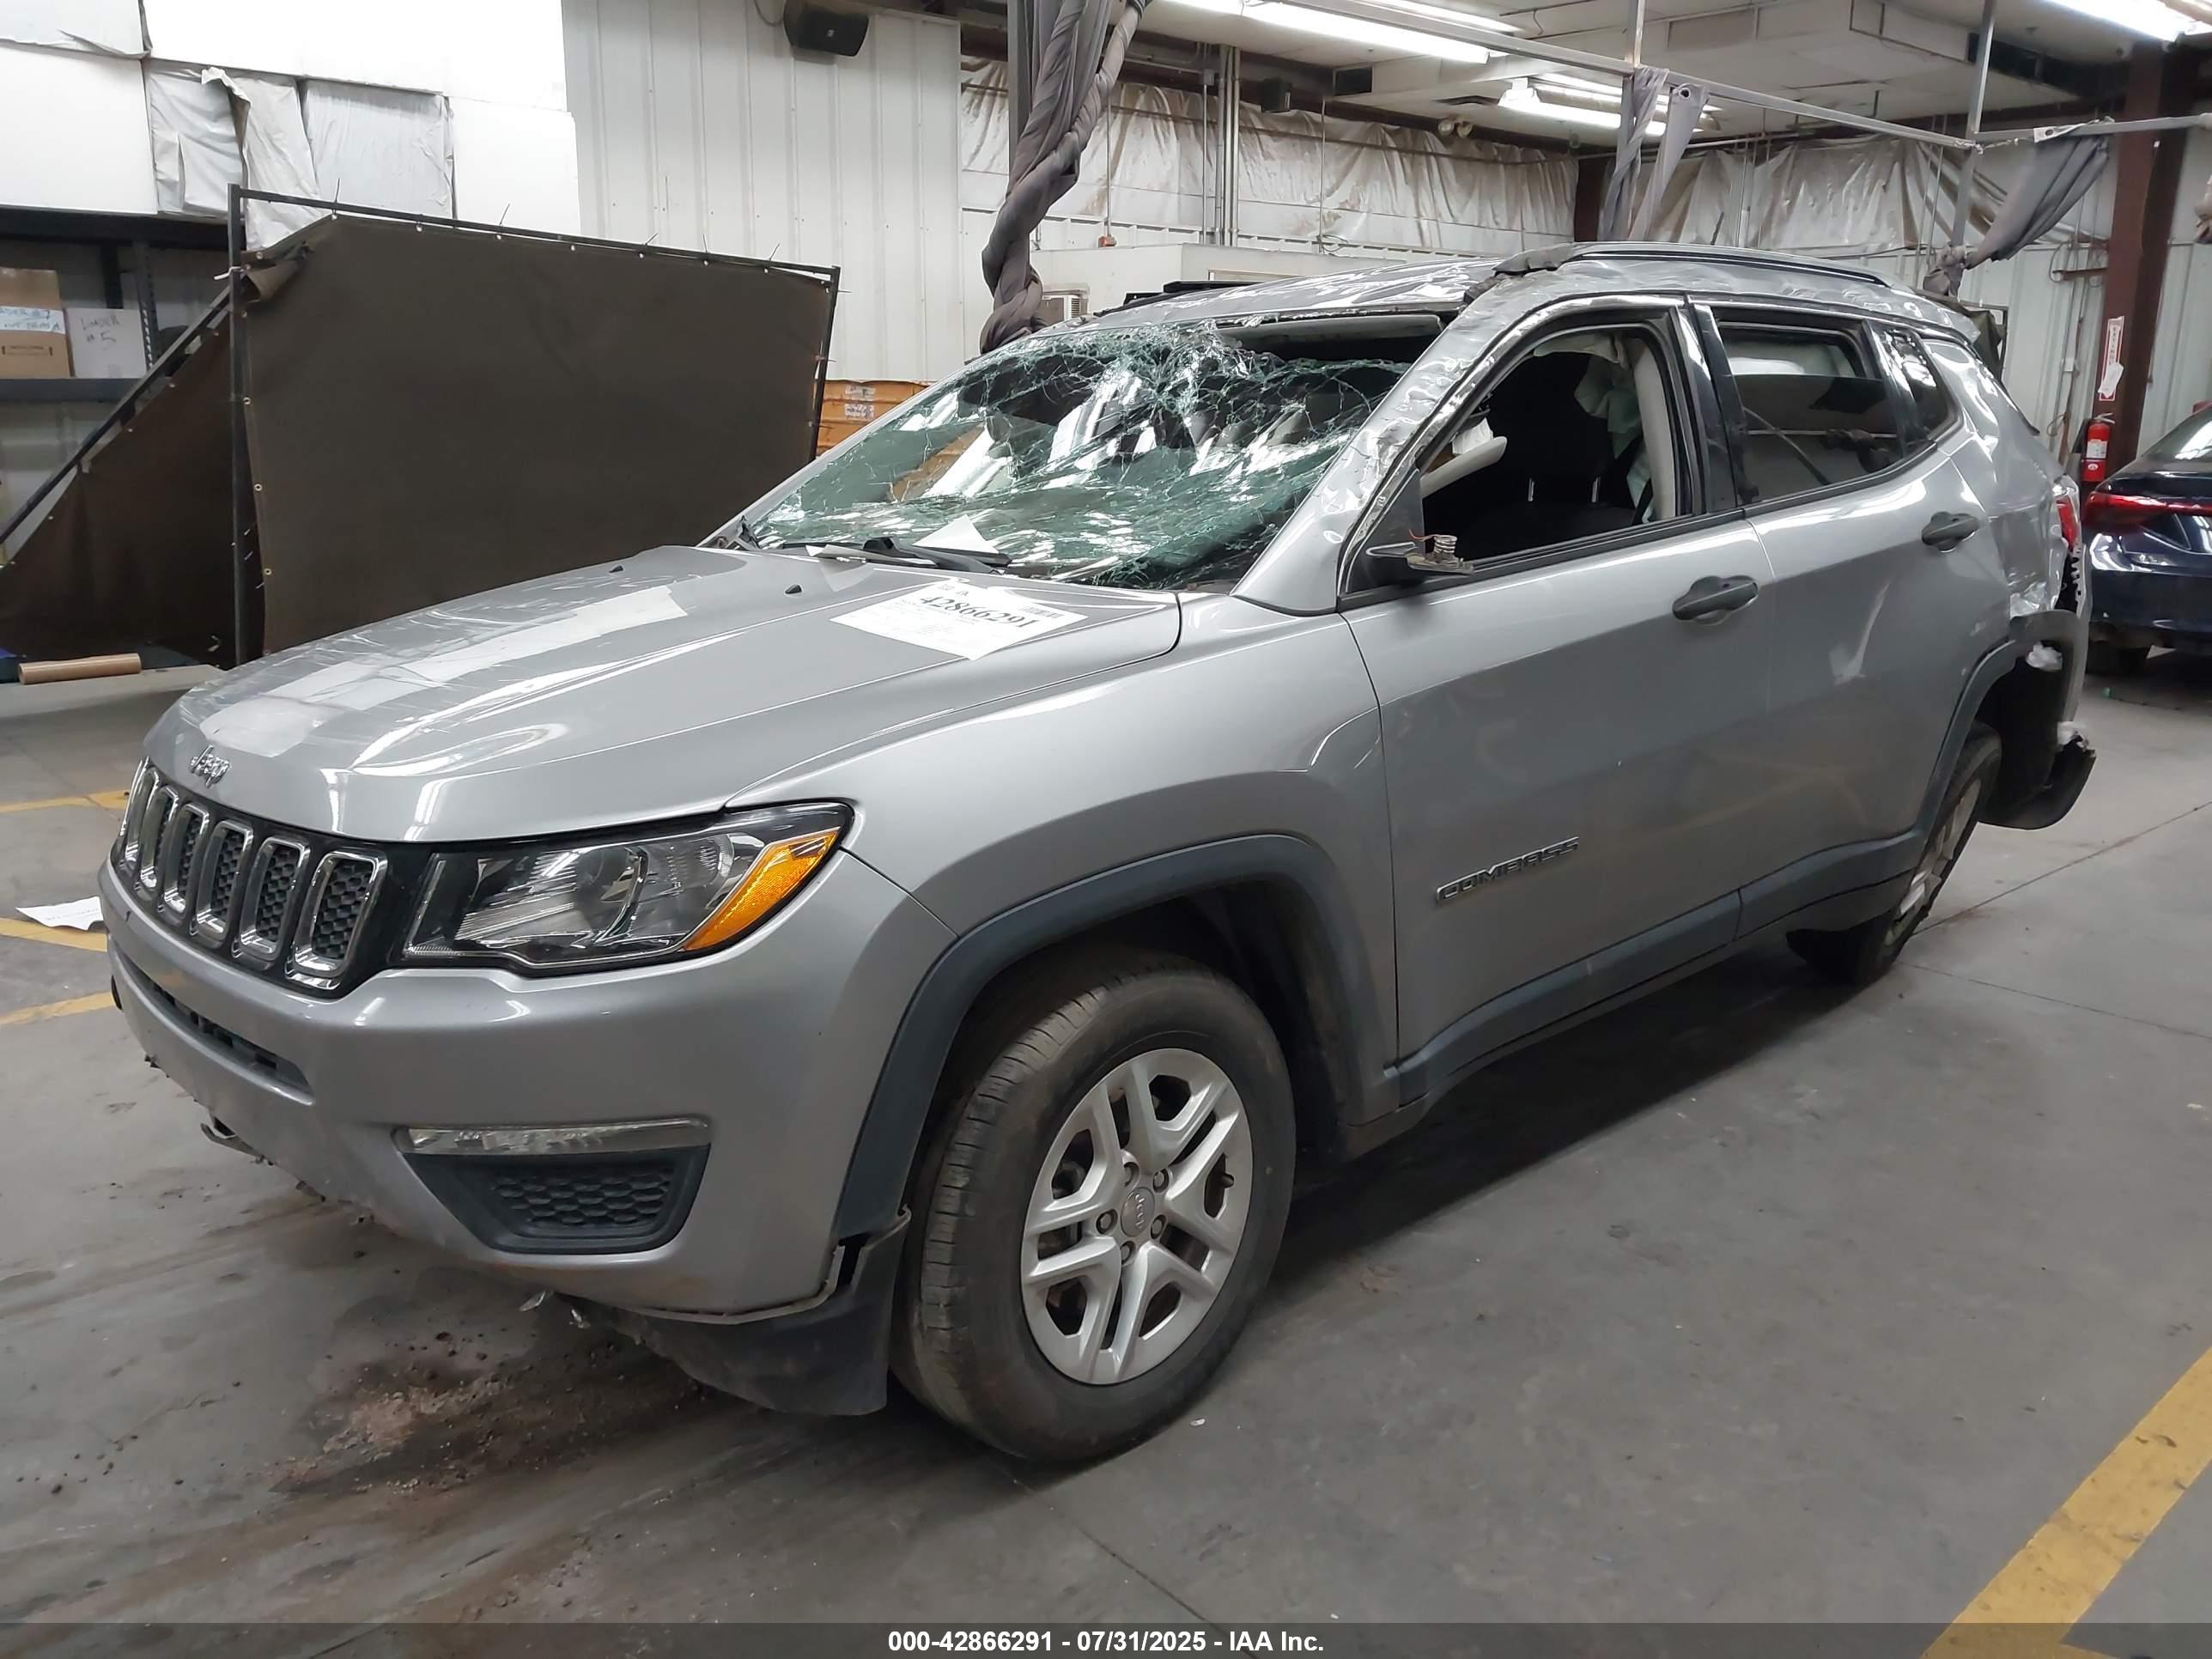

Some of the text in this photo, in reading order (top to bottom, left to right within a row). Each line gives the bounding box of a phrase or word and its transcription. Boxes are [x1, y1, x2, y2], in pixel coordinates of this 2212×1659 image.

[920, 595, 1040, 629] 42866291
[188, 744, 233, 788] Jeep
[1436, 836, 1580, 904] COMPASS
